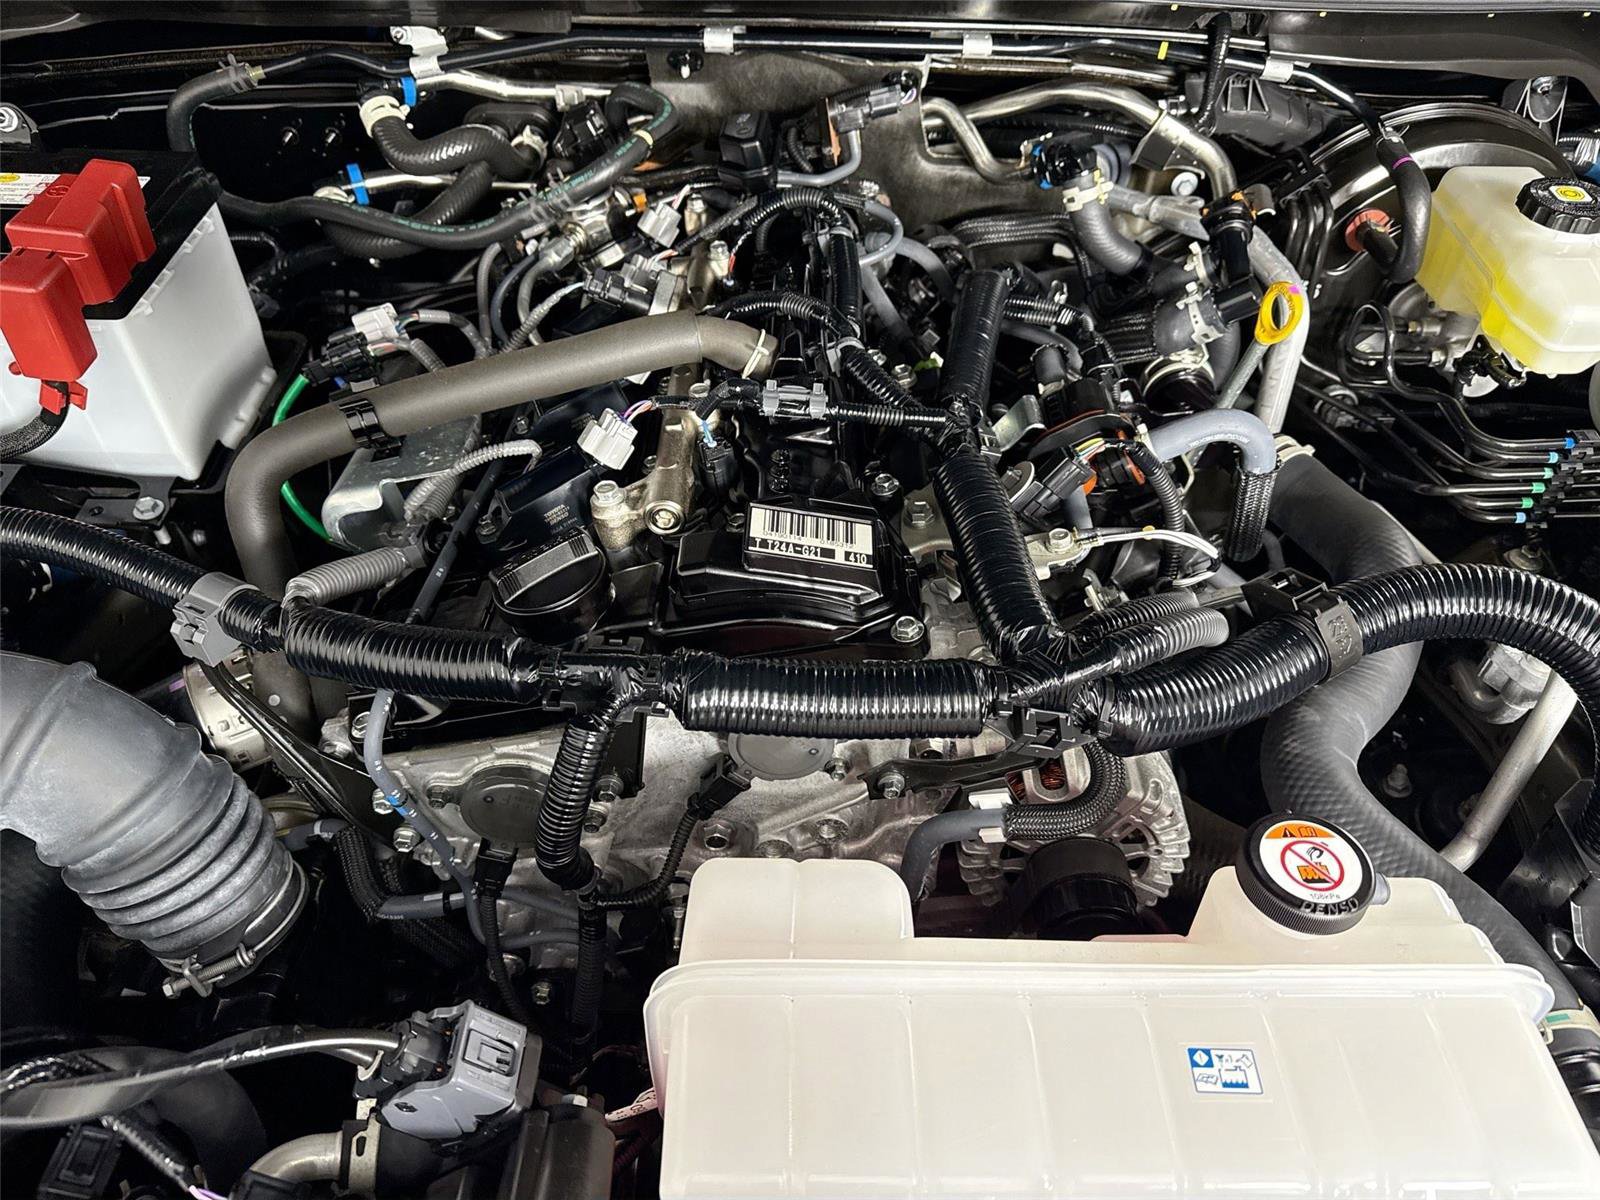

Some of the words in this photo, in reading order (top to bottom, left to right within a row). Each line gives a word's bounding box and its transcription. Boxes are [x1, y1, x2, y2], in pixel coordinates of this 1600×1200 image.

[767, 540, 821, 558] T24A-G21
[848, 552, 867, 564] 410
[1300, 898, 1358, 915] DENSO
